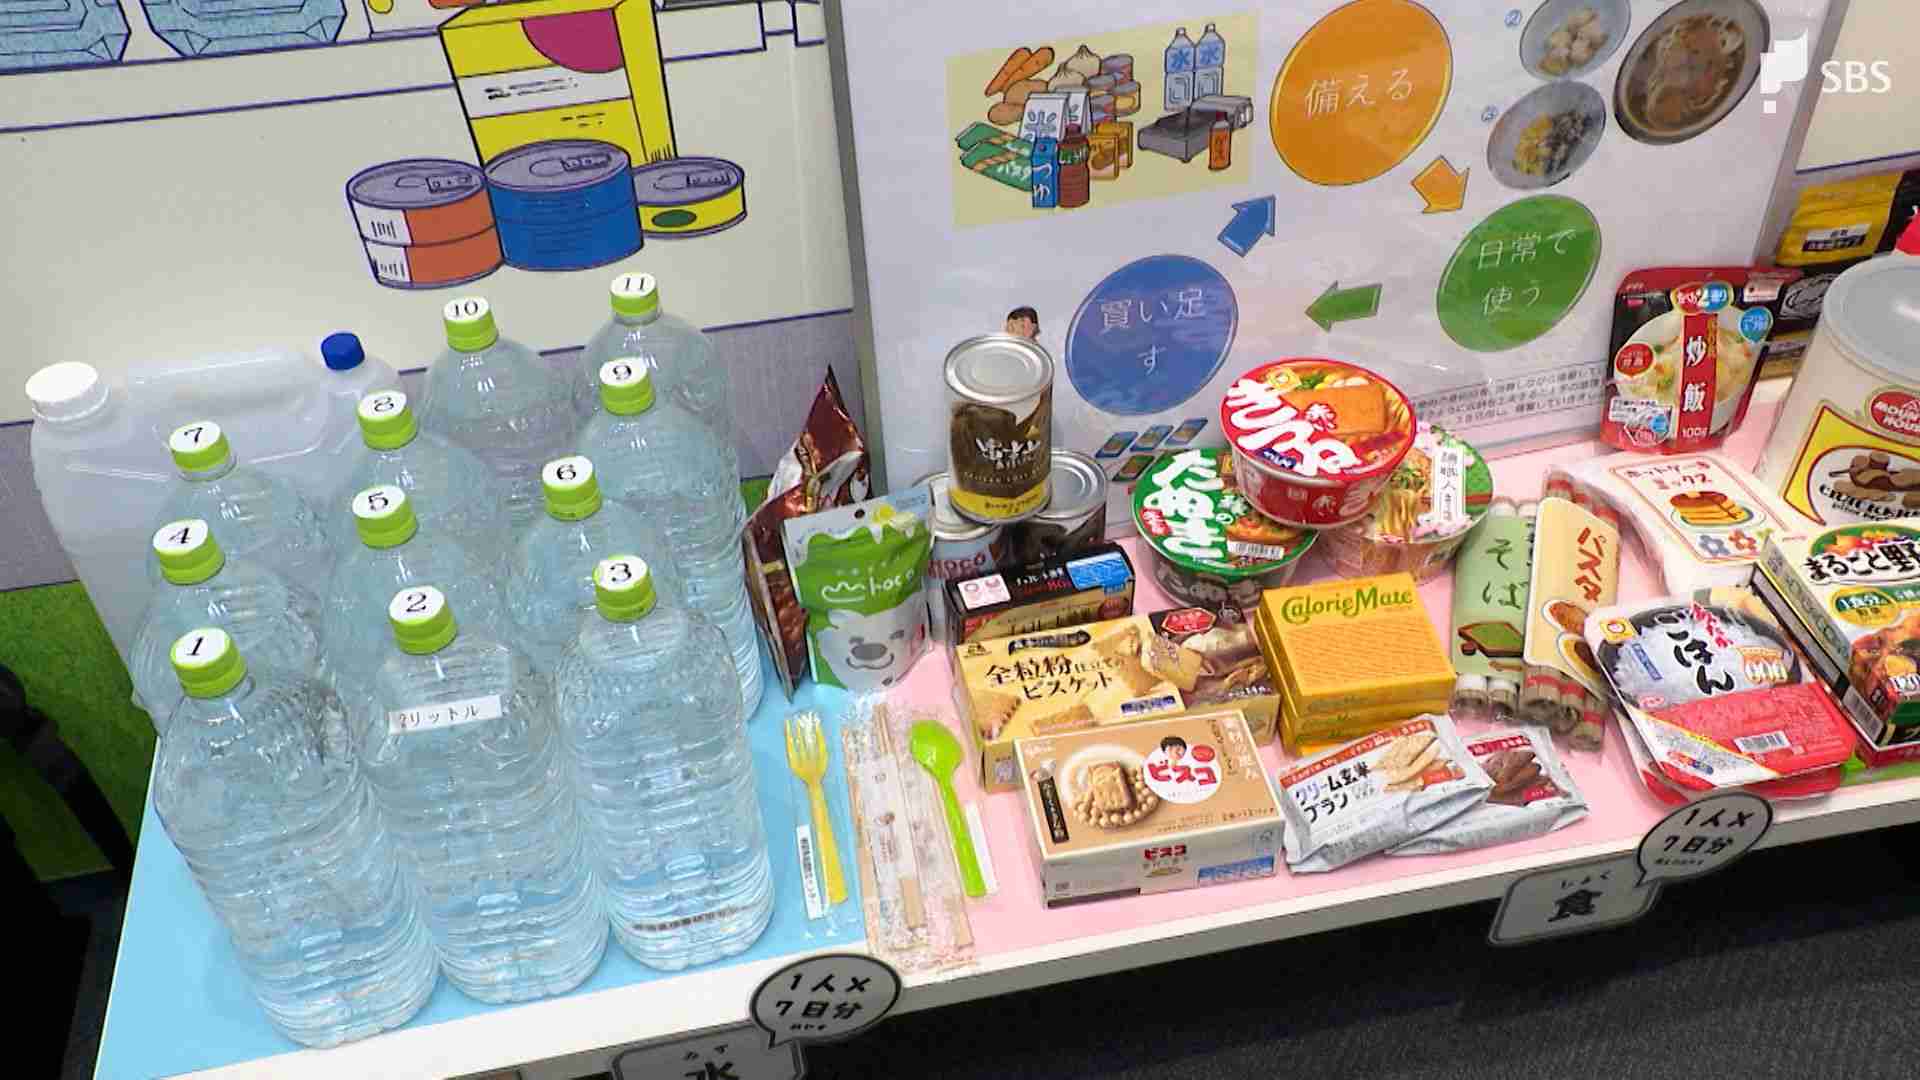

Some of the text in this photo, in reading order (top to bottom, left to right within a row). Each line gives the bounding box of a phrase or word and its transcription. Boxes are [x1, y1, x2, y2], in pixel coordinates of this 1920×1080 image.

[1306, 70, 1414, 116] 備える
[1478, 228, 1577, 270] 日常で
[623, 276, 647, 292] 11
[452, 300, 478, 317] 10
[1101, 288, 1208, 331] 買い足
[1482, 285, 1541, 315] 使う
[613, 362, 631, 381] 9
[1137, 345, 1168, 375] す
[1683, 335, 1707, 411] 炒飯
[372, 395, 396, 412] 8
[185, 427, 205, 444] 7
[1226, 378, 1364, 478] きつね
[556, 463, 577, 482] 6
[1626, 461, 1711, 479] ホットケーキ
[1654, 474, 1713, 491] ミックス
[368, 491, 389, 512] 5
[1142, 450, 1226, 562] たぬき
[168, 526, 192, 546] 4
[609, 561, 632, 584] 3
[1482, 538, 1530, 610] そば
[1575, 526, 1606, 603] パスタ
[1805, 541, 1920, 580] まるごと野
[406, 592, 427, 612] 2
[1281, 585, 1413, 625] CalorieMate
[188, 636, 206, 657] 1
[1654, 608, 1736, 696] ごはん
[1023, 670, 1114, 701] ビスケット
[398, 702, 482, 730] 2リットル
[1148, 759, 1218, 788] ビスコ
[1295, 760, 1373, 806] クリーム玄米
[1302, 792, 1349, 824] ブラン
[1143, 844, 1187, 861] ビスコ
[1664, 834, 1733, 854] 7日分
[775, 1001, 863, 1020] 7日分
